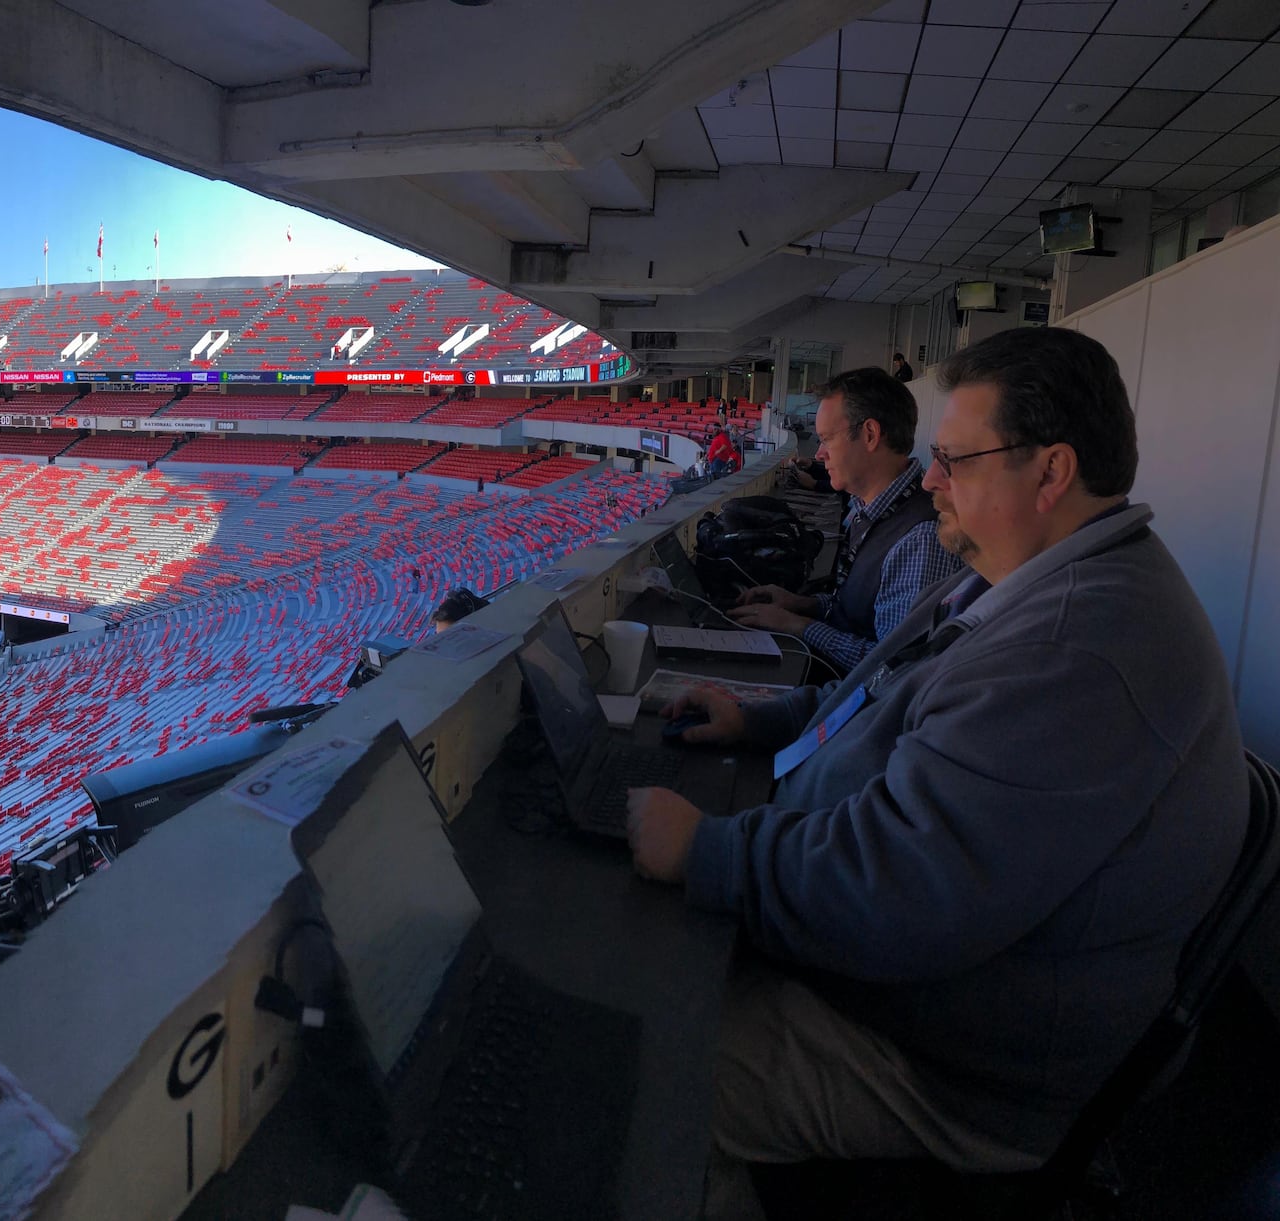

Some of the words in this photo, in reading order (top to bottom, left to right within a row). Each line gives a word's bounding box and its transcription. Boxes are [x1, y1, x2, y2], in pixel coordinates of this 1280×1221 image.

[430, 373, 455, 382] Piedmont
[503, 374, 524, 382] WELCOME
[534, 370, 560, 382] SANFORD
[563, 367, 585, 381] STADIUM
[134, 796, 160, 808] FUJINON
[167, 1013, 227, 1100] G
